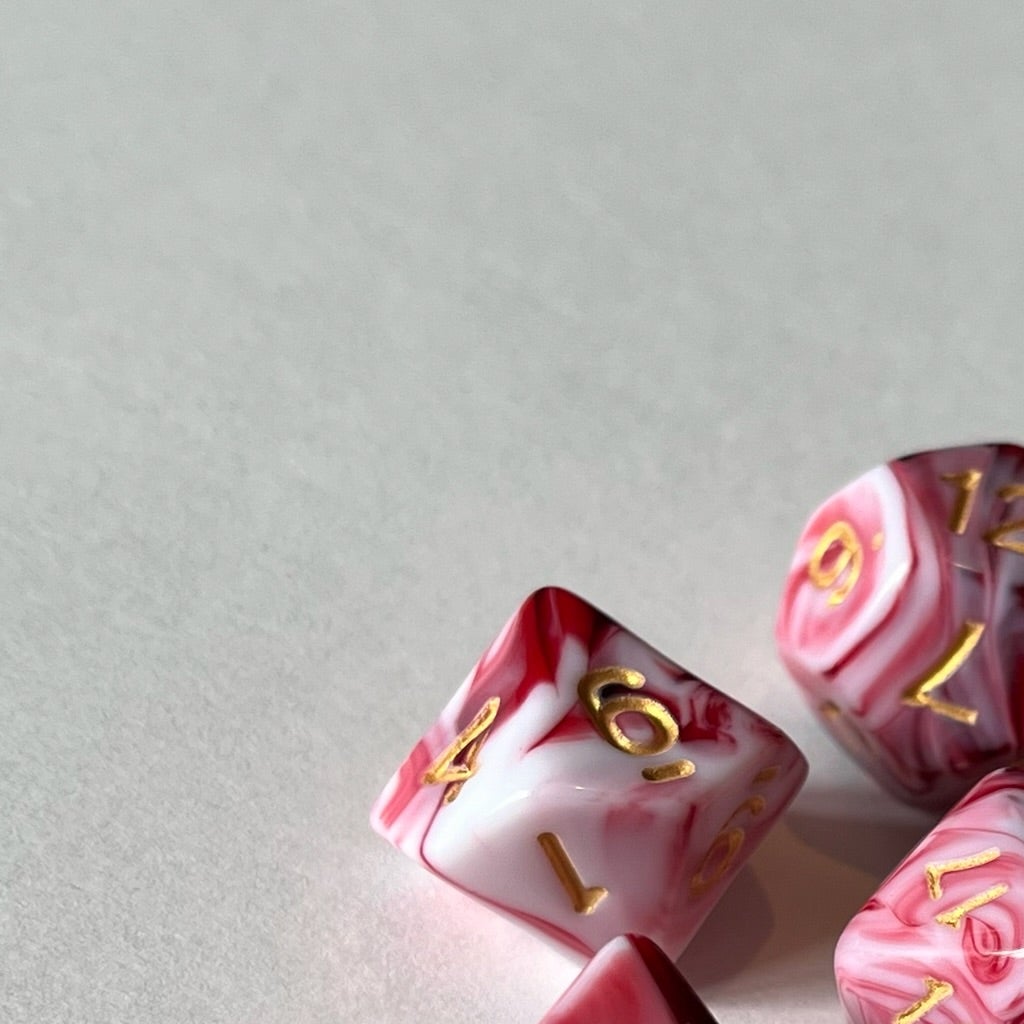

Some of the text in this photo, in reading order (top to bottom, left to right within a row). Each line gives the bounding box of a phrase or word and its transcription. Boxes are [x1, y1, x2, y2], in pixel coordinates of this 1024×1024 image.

[900, 622, 986, 725] 7
[421, 696, 501, 803] 4
[537, 832, 609, 914] 1
